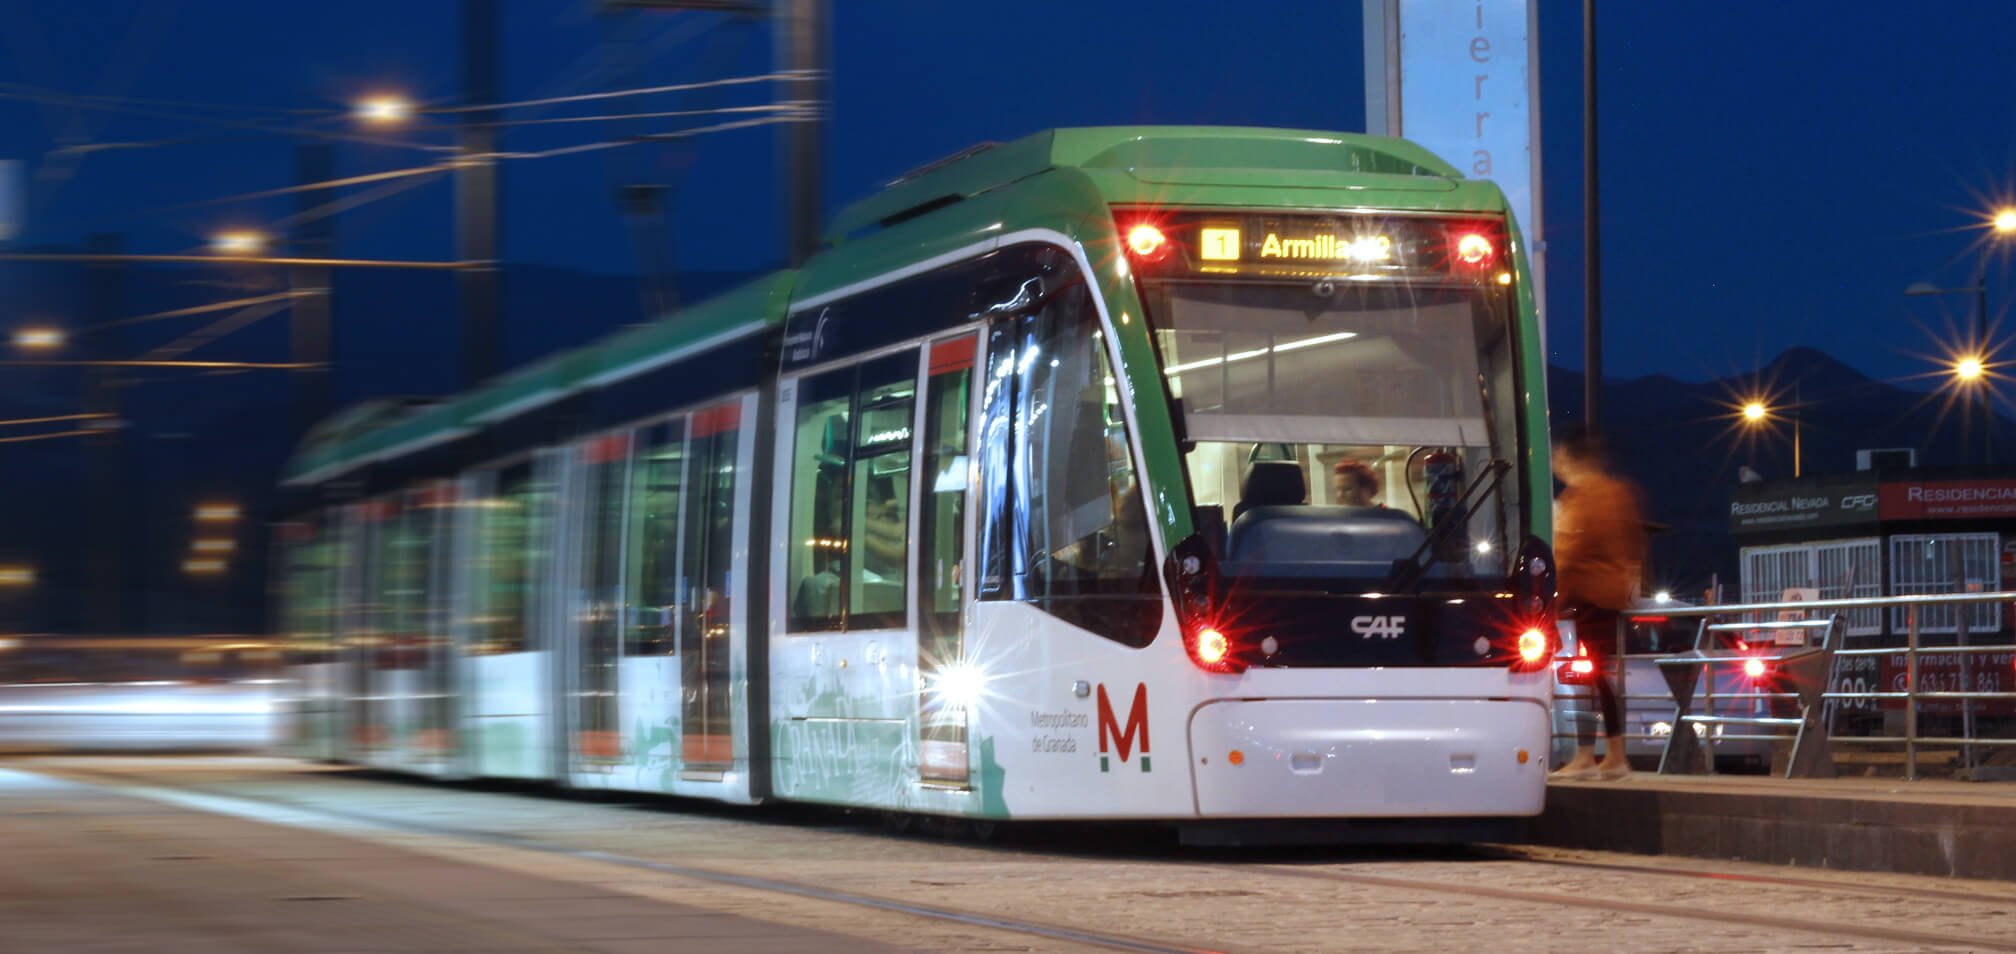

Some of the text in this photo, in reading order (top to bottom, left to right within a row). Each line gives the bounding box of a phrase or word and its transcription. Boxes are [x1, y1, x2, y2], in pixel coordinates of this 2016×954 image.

[1261, 233, 1349, 259] Armilla
[1350, 615, 1406, 639] CAF
[1031, 710, 1088, 729] Metropolitano
[1097, 682, 1151, 773] M
[1032, 735, 1077, 752] de Granada
